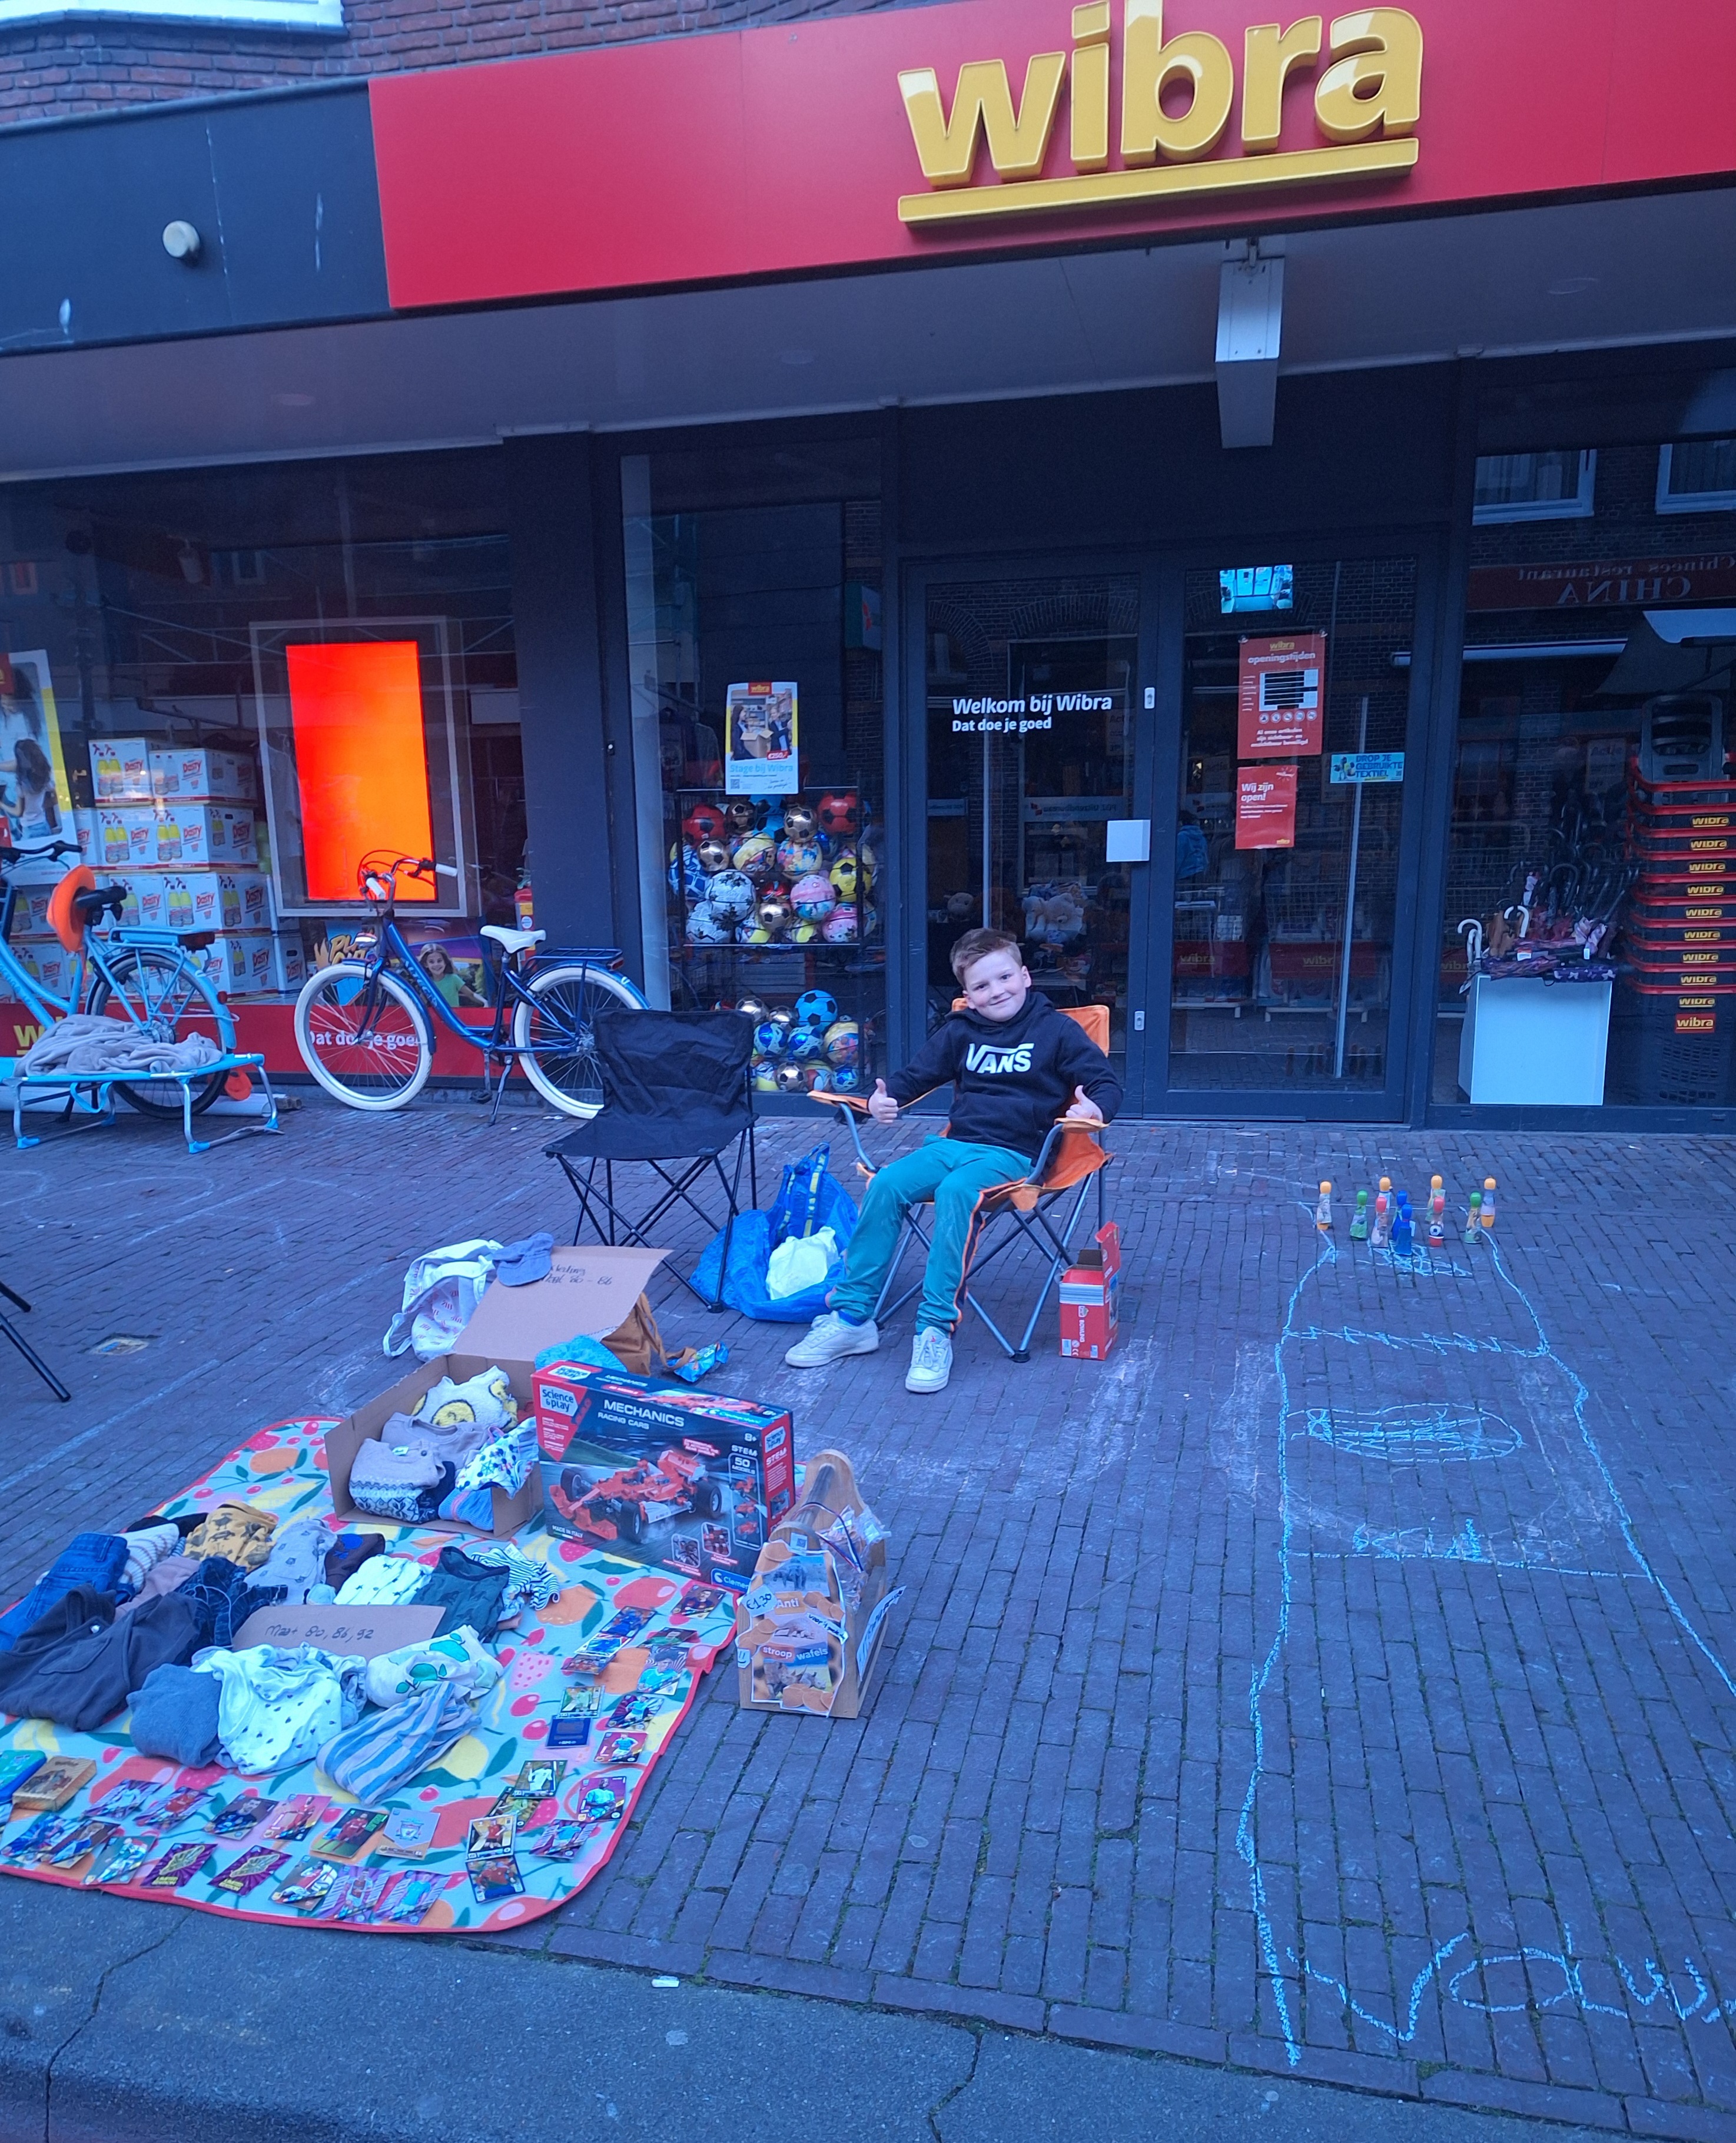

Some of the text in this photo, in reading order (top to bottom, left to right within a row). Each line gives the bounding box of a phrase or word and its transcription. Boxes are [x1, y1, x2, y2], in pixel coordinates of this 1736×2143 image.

[898, 0, 1423, 187] wibra
[1270, 641, 1294, 651] wibra
[1248, 651, 1316, 665] openingstijden
[751, 684, 770, 693] wibra
[952, 694, 1112, 715] Welkom bij Wibra
[952, 716, 1052, 733] Dat doe je goed
[729, 765, 754, 774] Stage
[755, 764, 765, 774] bij
[1355, 761, 1403, 770] GEBRUIKTE
[1355, 769, 1389, 778] TEXTIEL
[1242, 782, 1274, 792] Wij zijn
[1241, 793, 1266, 802] open!
[1677, 1017, 1714, 1027] wibra
[387, 1034, 419, 1050] goe
[966, 1043, 1035, 1074] VANS
[542, 1389, 574, 1404] Science
[604, 1399, 685, 1427] MECHANICS
[598, 1412, 650, 1430] RACING CARS
[744, 1432, 758, 1442] 8+
[731, 1445, 758, 1457] STEM
[766, 1447, 788, 1465] STEM
[735, 1457, 751, 1468] 50
[732, 1464, 755, 1475] MODELS
[746, 1593, 772, 1610] €1,30
[776, 1597, 799, 1609] Anti
[265, 1624, 298, 1637] Maat
[763, 1646, 829, 1661] stroop wafels
